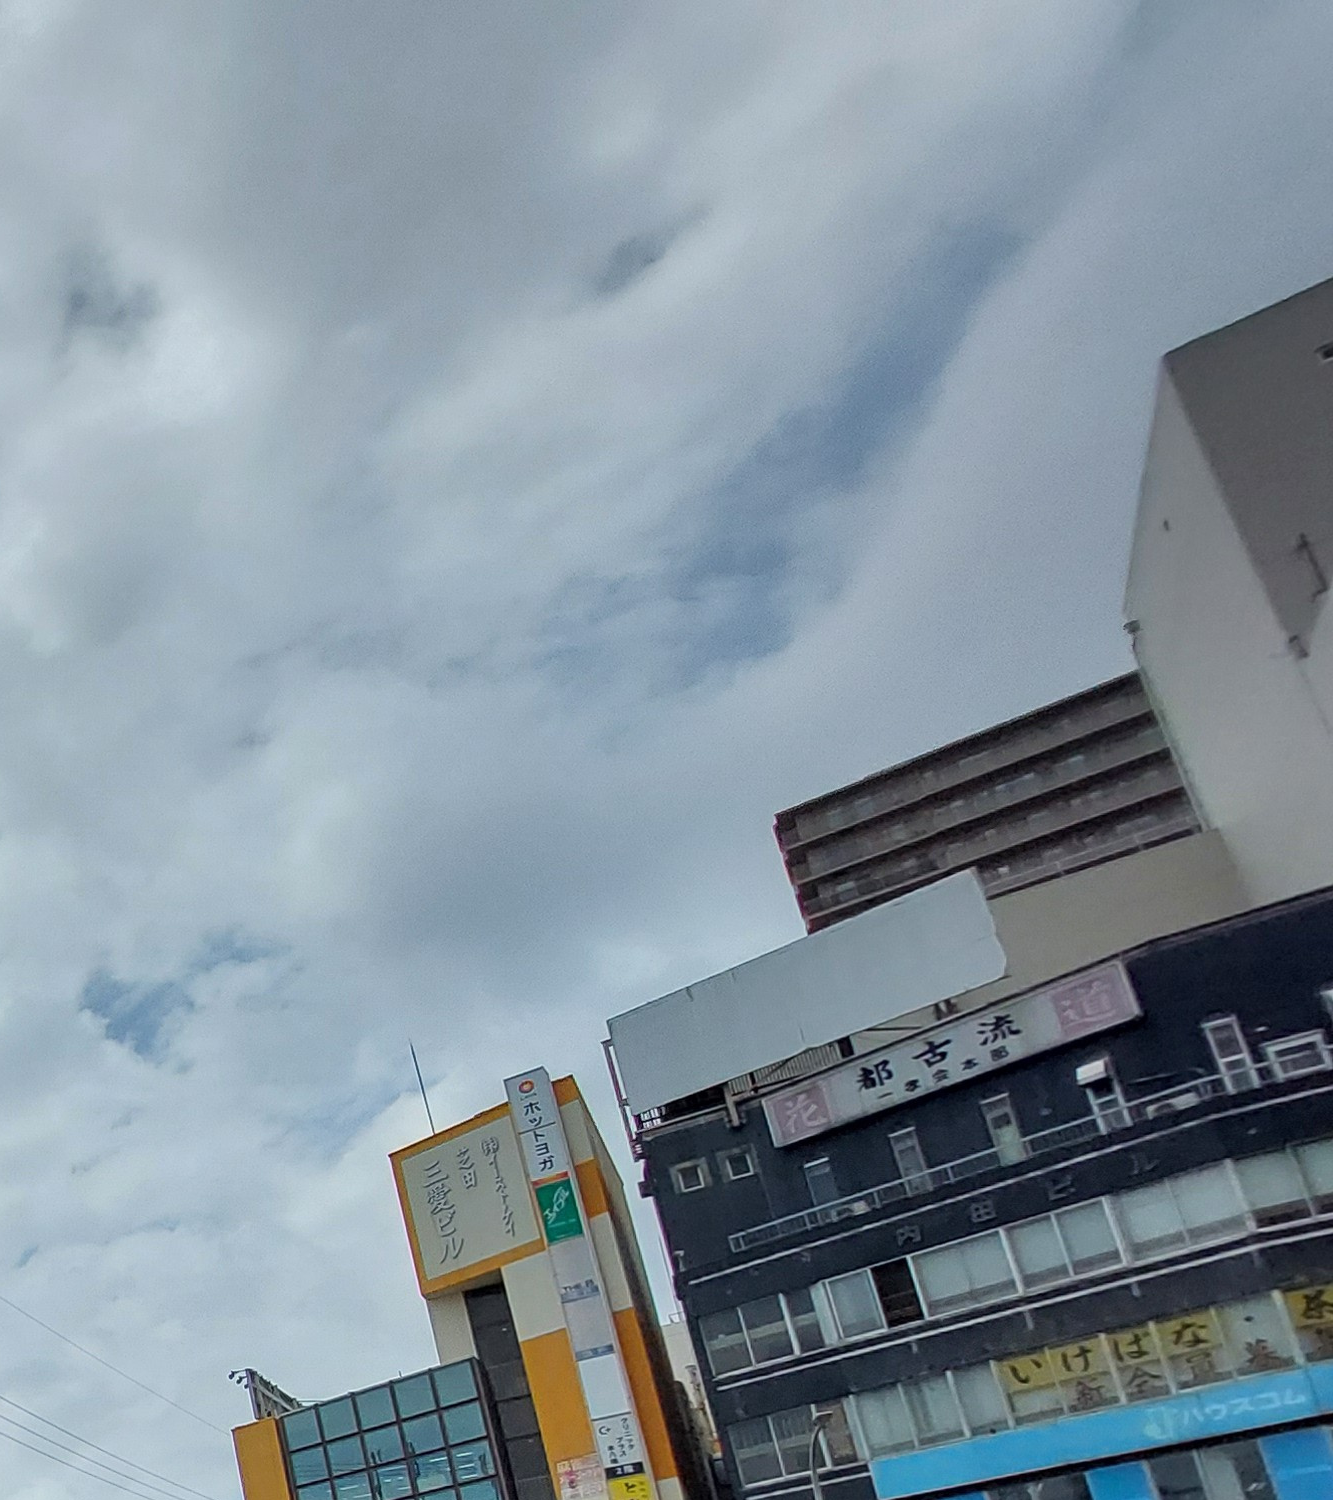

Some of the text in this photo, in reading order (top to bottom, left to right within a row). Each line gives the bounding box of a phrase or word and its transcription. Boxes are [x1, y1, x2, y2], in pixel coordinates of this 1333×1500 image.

[858, 1013, 1023, 1092] 都古流
[523, 1101, 555, 1172] ホットヨガ
[1009, 1321, 1208, 1385] いけばな
[1181, 1387, 1308, 1423] ハウスコム
